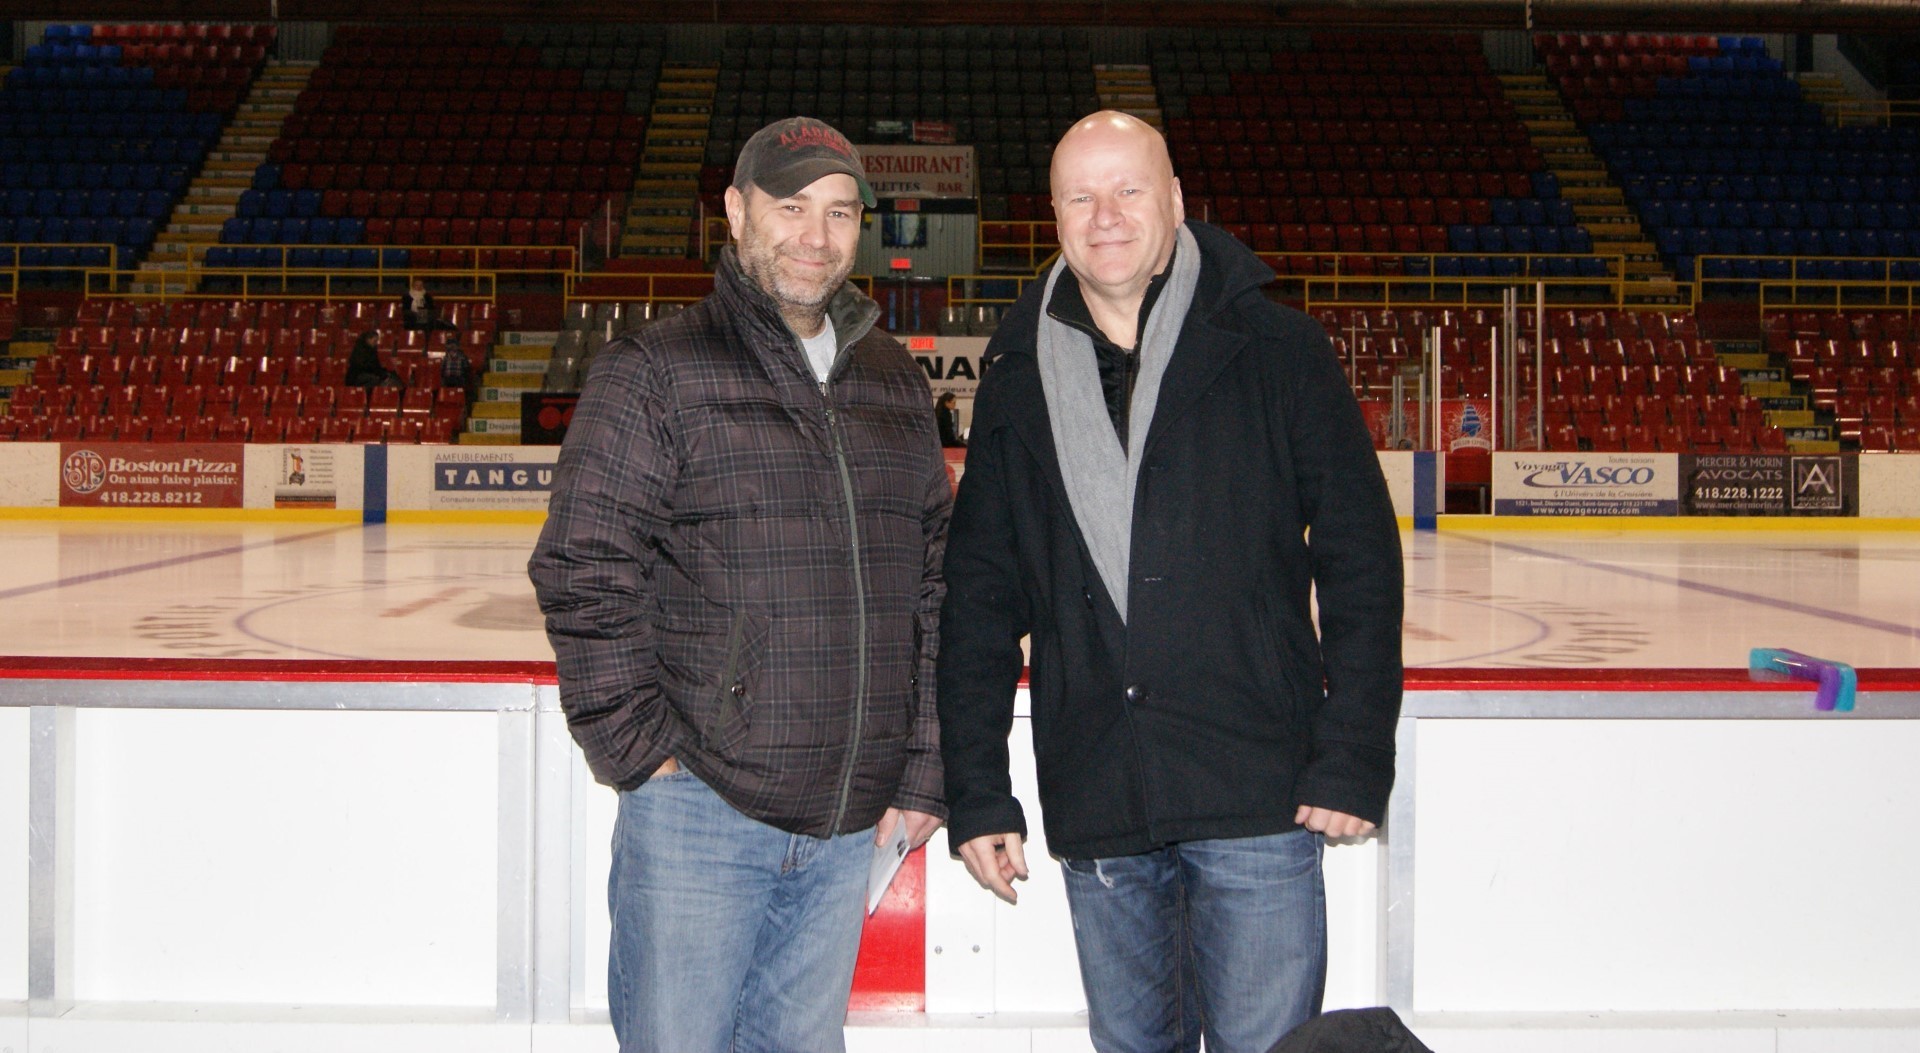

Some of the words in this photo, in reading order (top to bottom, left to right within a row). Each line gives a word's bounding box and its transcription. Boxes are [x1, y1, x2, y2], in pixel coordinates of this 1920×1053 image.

[780, 124, 851, 153] ALABAMA
[861, 155, 963, 173] ESTAURANT
[937, 182, 963, 192] BAR
[910, 337, 935, 349] SORTIE
[435, 453, 514, 462] AMEUBLEMENTS
[1608, 456, 1629, 464] Toutes
[1696, 457, 1737, 467] MERCIER
[1739, 457, 1748, 467] &
[1750, 457, 1783, 467] MORIN
[109, 457, 182, 473] Boston
[182, 458, 237, 473] Pizza
[444, 469, 552, 486] TANGU
[1557, 462, 1655, 485] VASCO
[1696, 469, 1783, 480] AVOCATS
[109, 474, 127, 484] On
[129, 474, 159, 484] aime
[162, 474, 190, 484] faire
[193, 474, 238, 487] plaisir.
[100, 491, 203, 504] 418.228.8212
[1695, 487, 1783, 499] 418.228.1222
[1532, 506, 1640, 515] www.voyagevasco.com
[1695, 501, 1784, 509] www.merciermorin.ca
